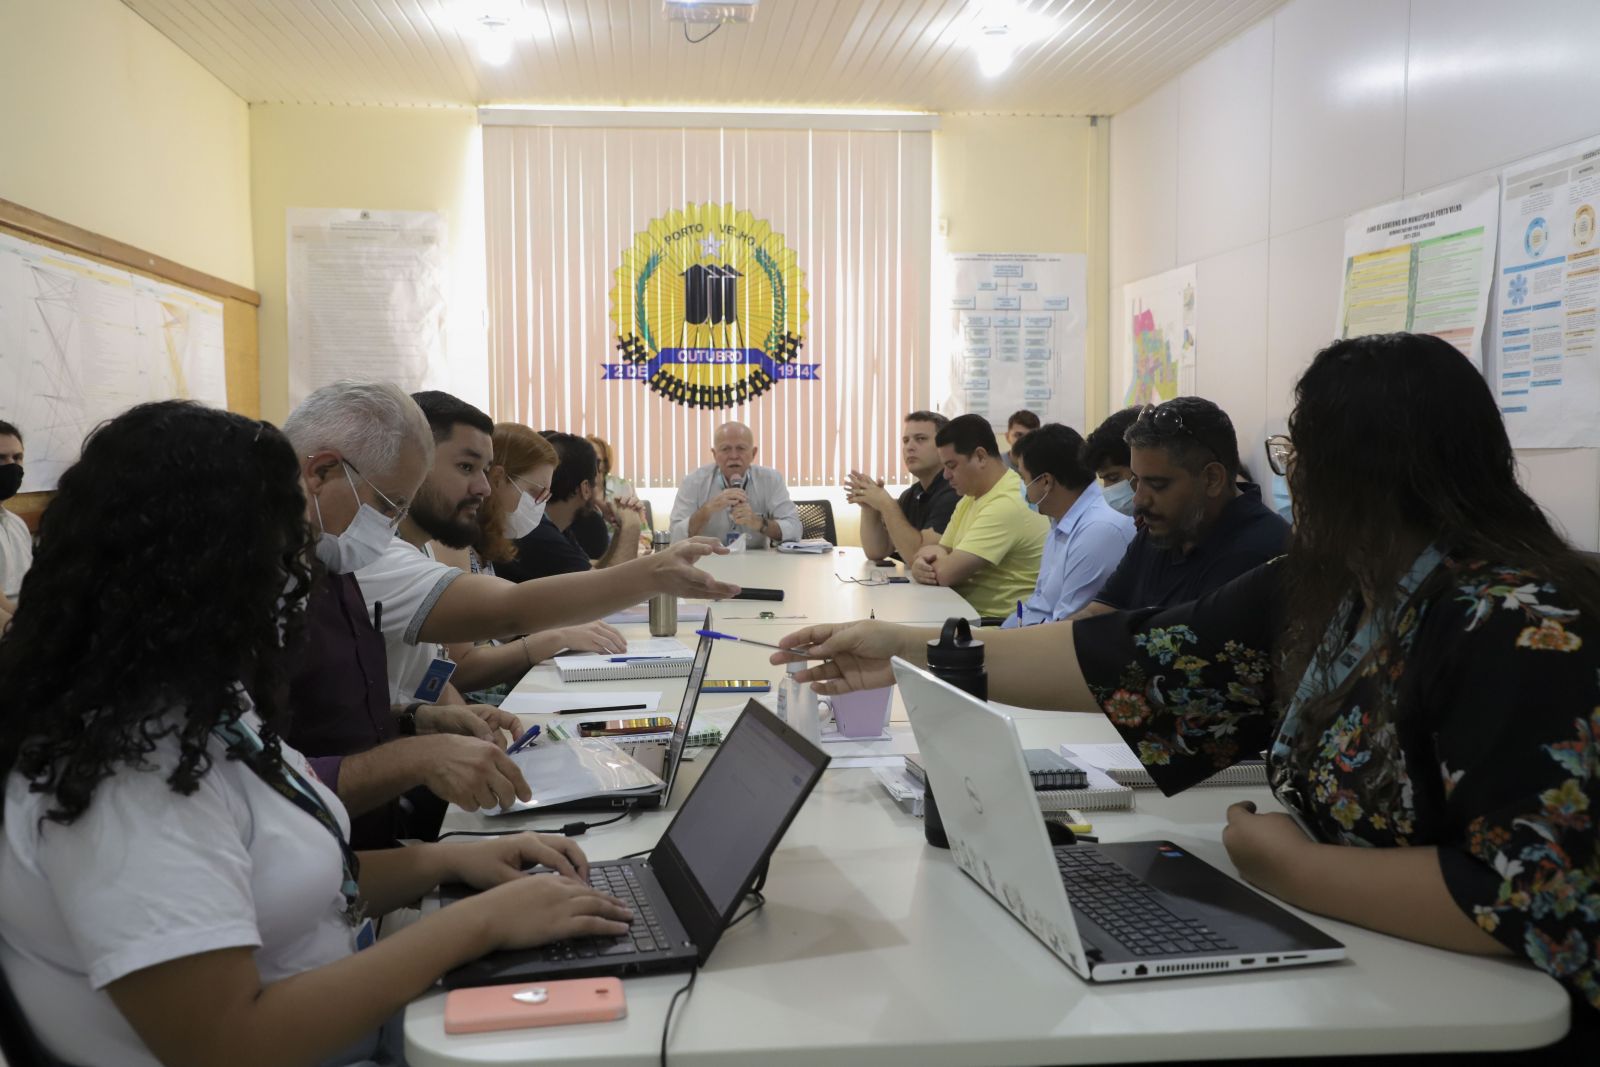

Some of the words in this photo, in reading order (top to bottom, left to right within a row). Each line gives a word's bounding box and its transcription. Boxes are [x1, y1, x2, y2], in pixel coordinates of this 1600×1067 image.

[664, 223, 704, 246] PORTO
[614, 365, 623, 377] 2
[627, 365, 647, 377] DE
[677, 350, 743, 362] OUTUBRO
[777, 365, 810, 377] 1914
